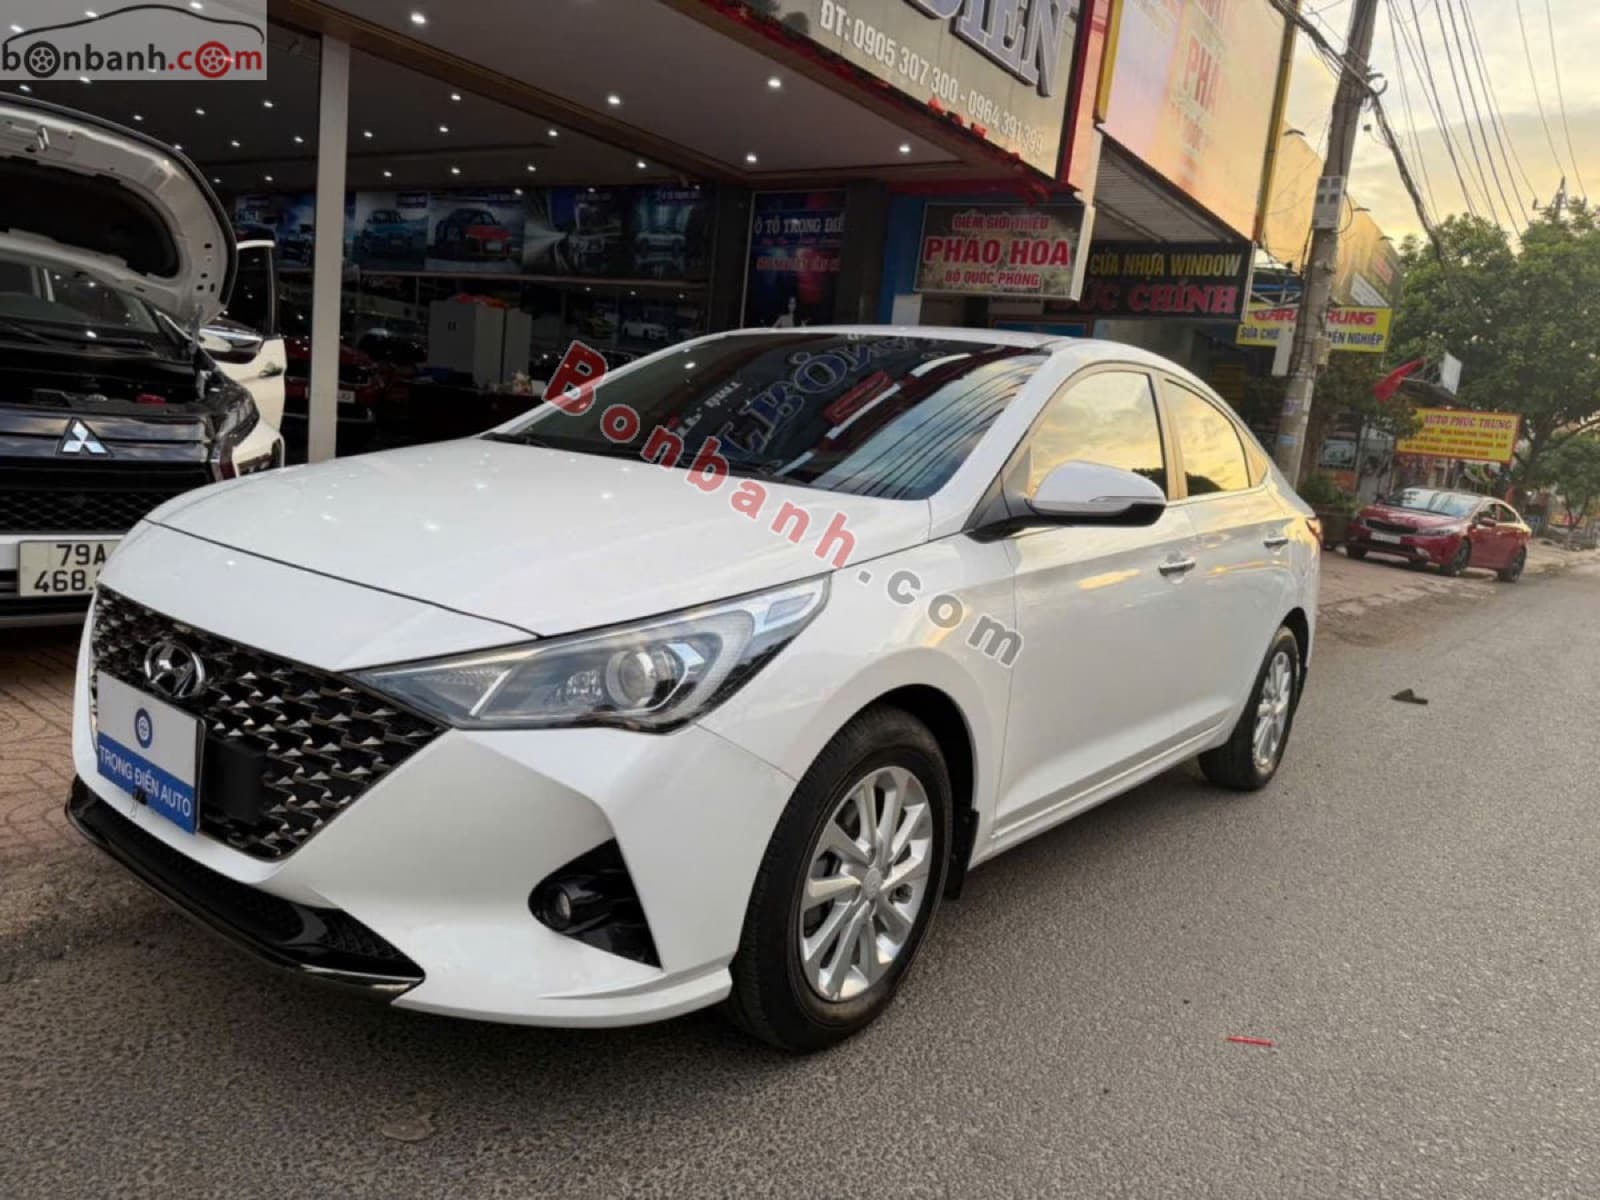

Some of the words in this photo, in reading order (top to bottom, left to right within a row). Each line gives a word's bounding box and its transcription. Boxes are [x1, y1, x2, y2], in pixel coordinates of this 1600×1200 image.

[853, 19, 897, 68] 0905
[898, 49, 930, 86] 307
[930, 66, 958, 104] 300
[967, 90, 1000, 128] 0964
[1000, 111, 1022, 141] 391
[1021, 128, 1043, 155] 399
[1009, 239, 1070, 266] HOA
[1170, 253, 1241, 277] WINDOW
[160, 784, 192, 817] AUTO
